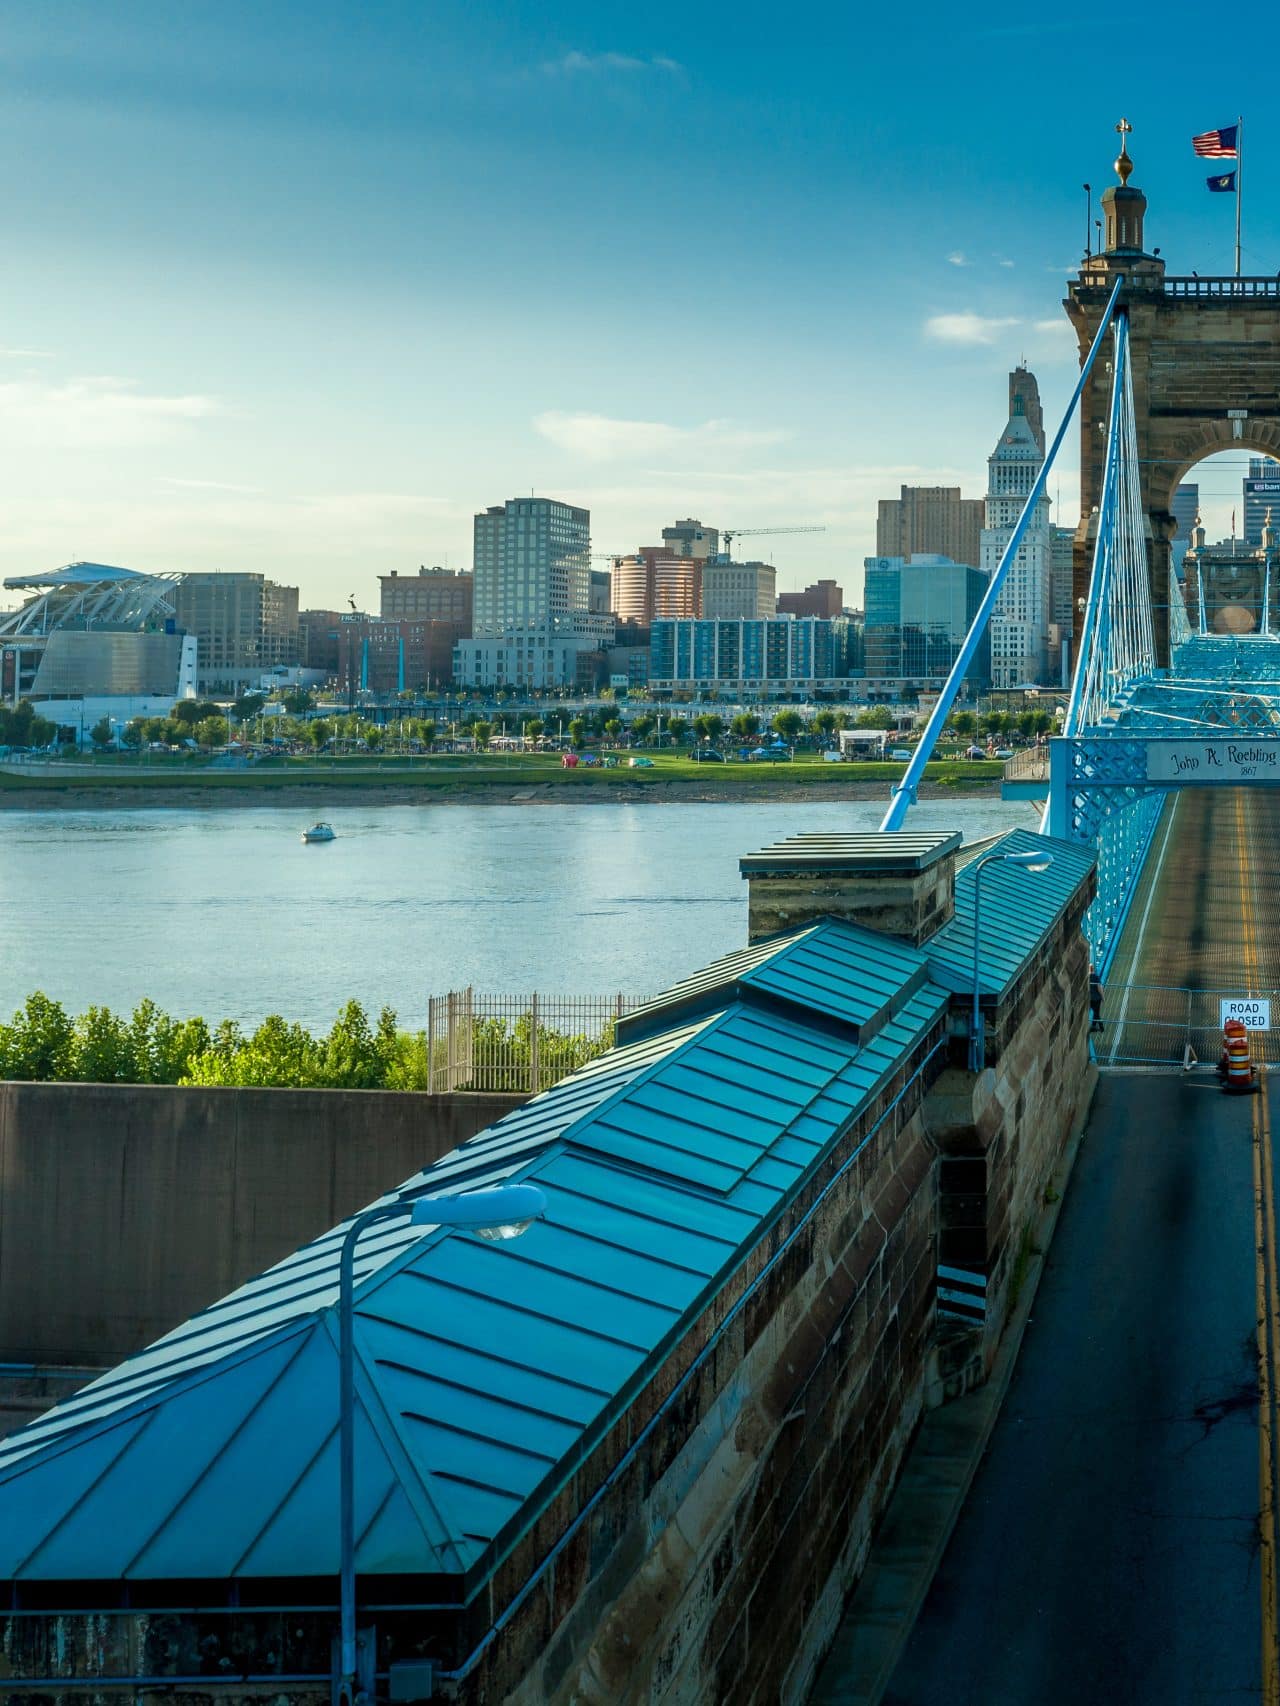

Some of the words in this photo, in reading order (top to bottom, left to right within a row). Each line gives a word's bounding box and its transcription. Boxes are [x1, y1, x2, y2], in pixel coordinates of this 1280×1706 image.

[1171, 754, 1199, 775] John
[1227, 745, 1277, 766] Roebling
[1230, 1003, 1259, 1013] ROAD
